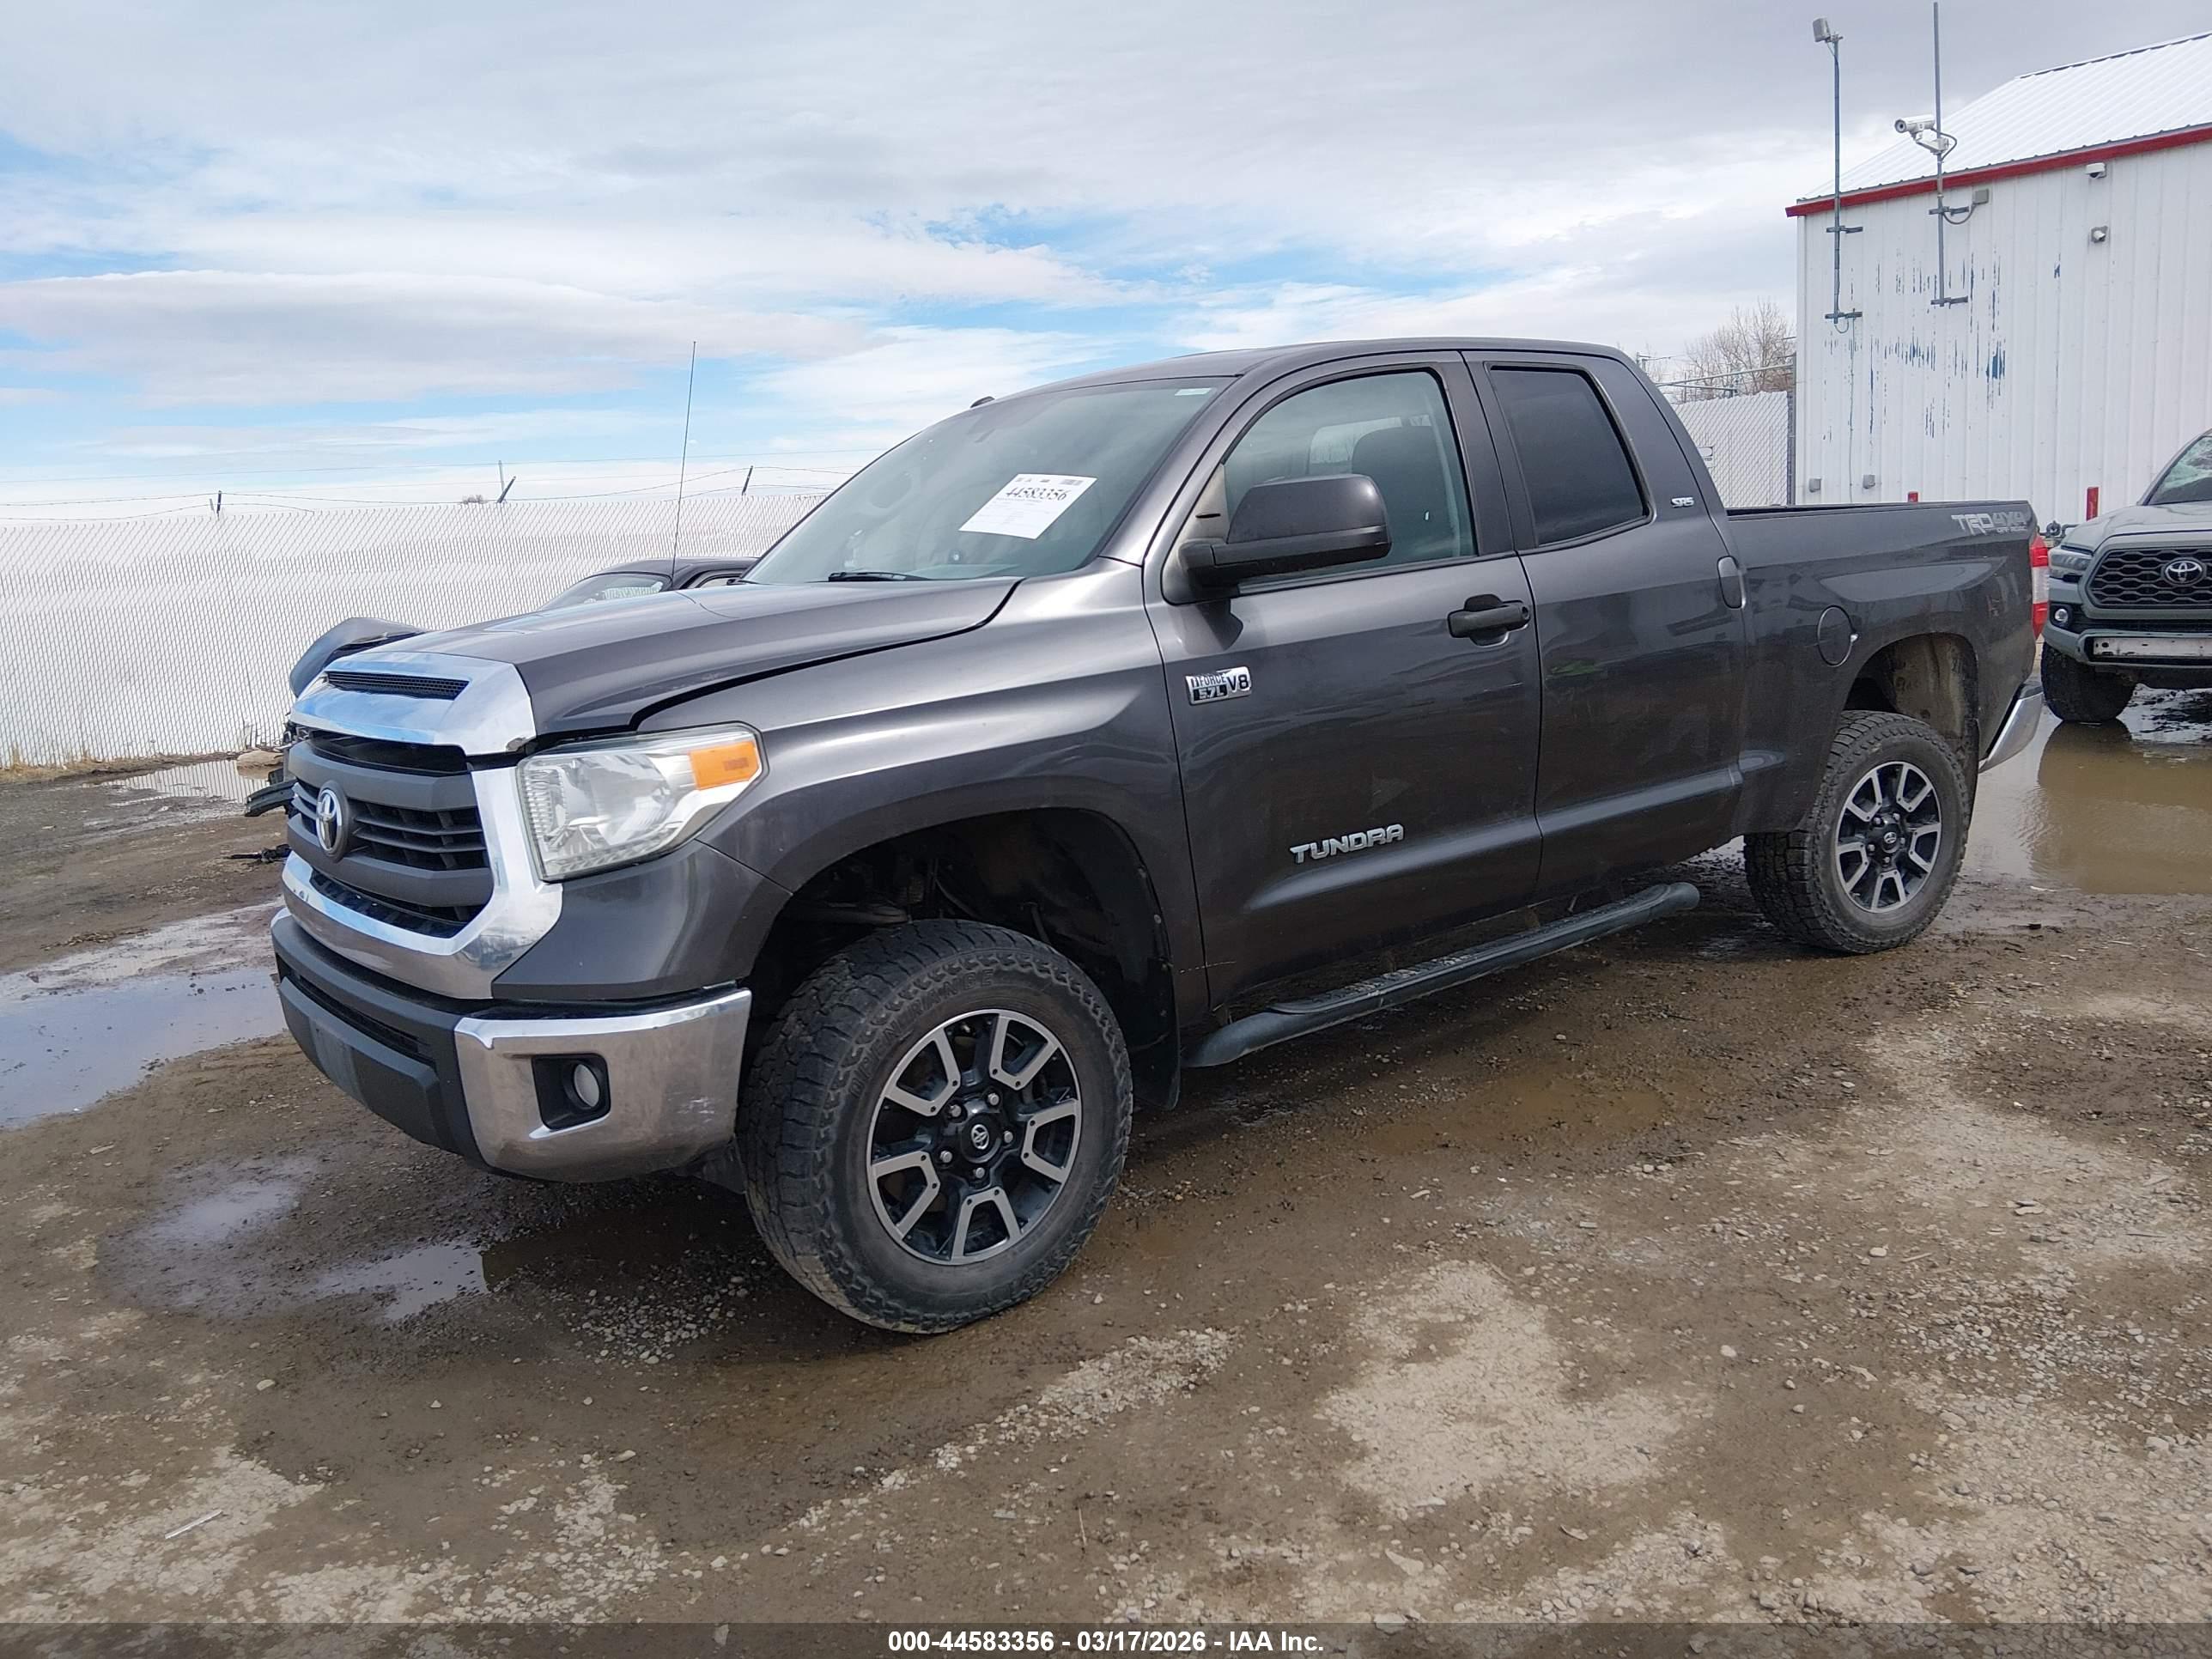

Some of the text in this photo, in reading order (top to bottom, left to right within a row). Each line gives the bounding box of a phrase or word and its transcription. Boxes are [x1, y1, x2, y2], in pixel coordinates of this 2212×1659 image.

[1006, 487, 1071, 501] 44583356
[1951, 514, 1995, 536] TRD
[1226, 673, 1249, 691] V8
[1198, 685, 1225, 700] 5.7L
[1290, 823, 1404, 864] TUNDRA
